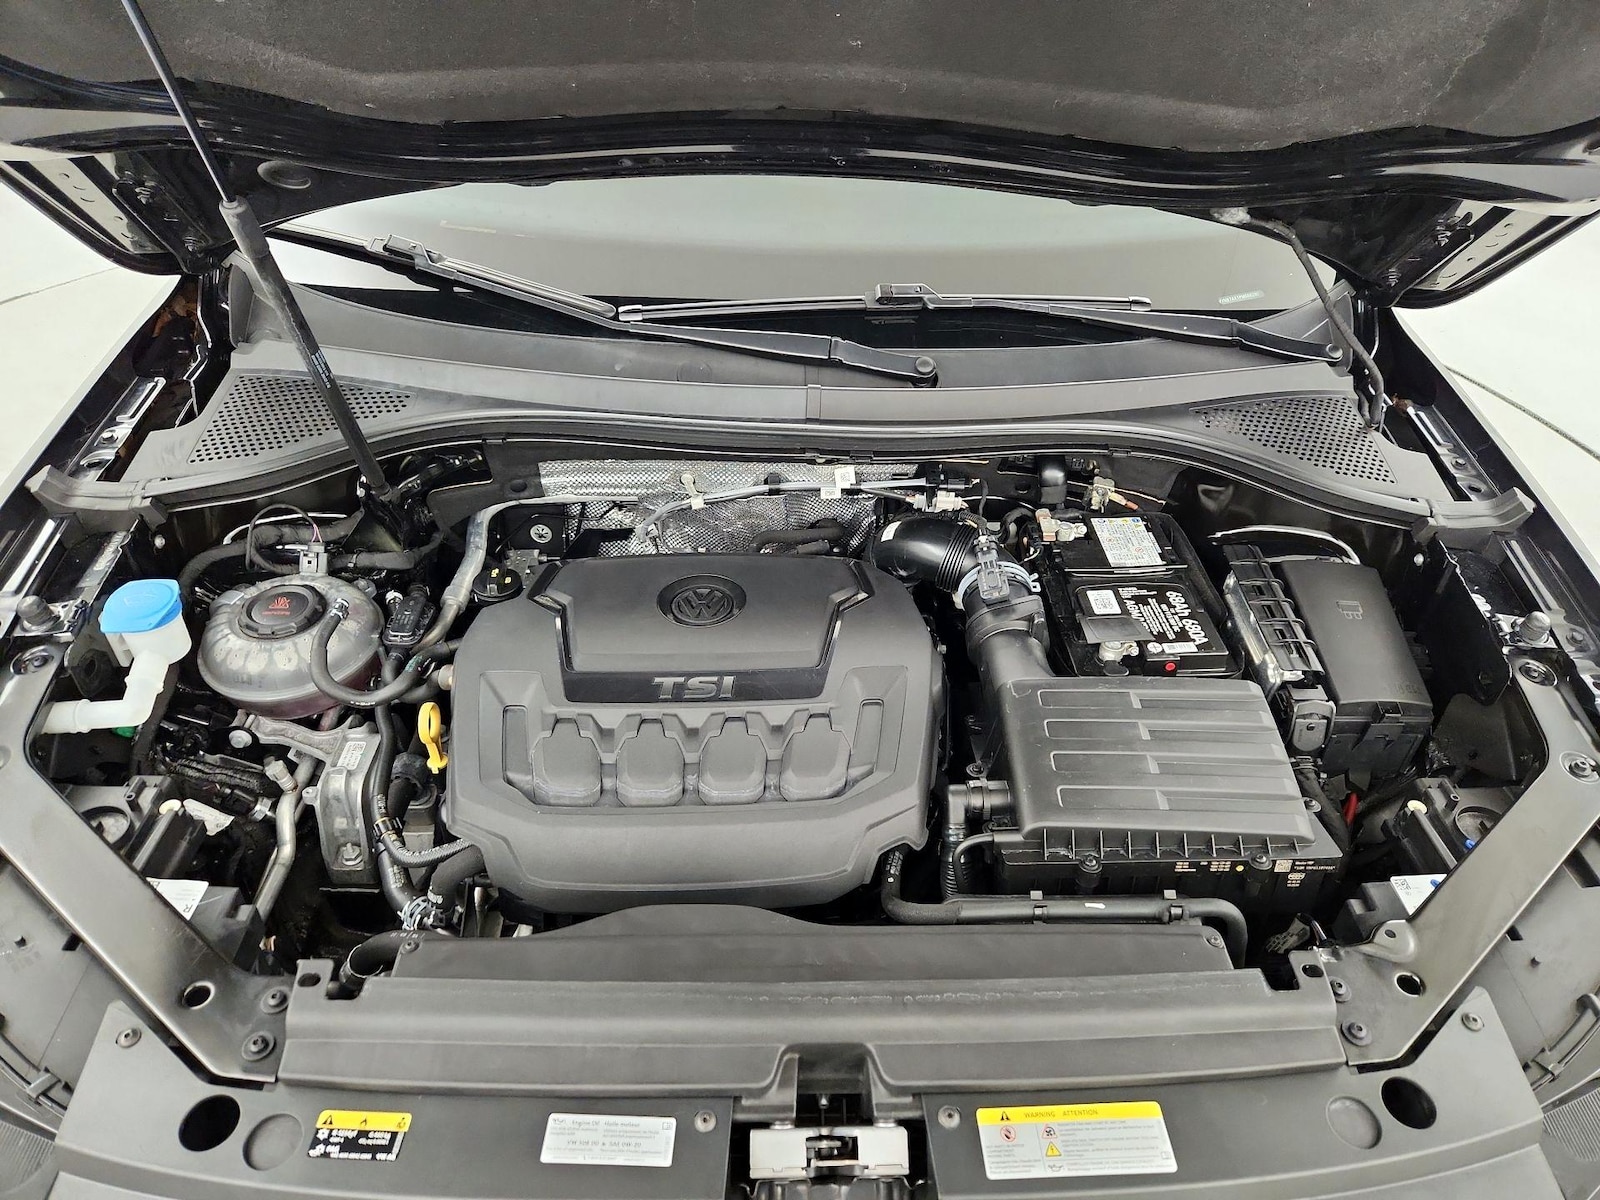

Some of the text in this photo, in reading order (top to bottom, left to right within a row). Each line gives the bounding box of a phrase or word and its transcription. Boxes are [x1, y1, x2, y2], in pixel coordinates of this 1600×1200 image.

[1166, 592, 1192, 617] 68Ah
[1182, 619, 1209, 645] 680A
[653, 675, 737, 700] TSI
[1023, 1108, 1099, 1119] WARNING ATTENTION
